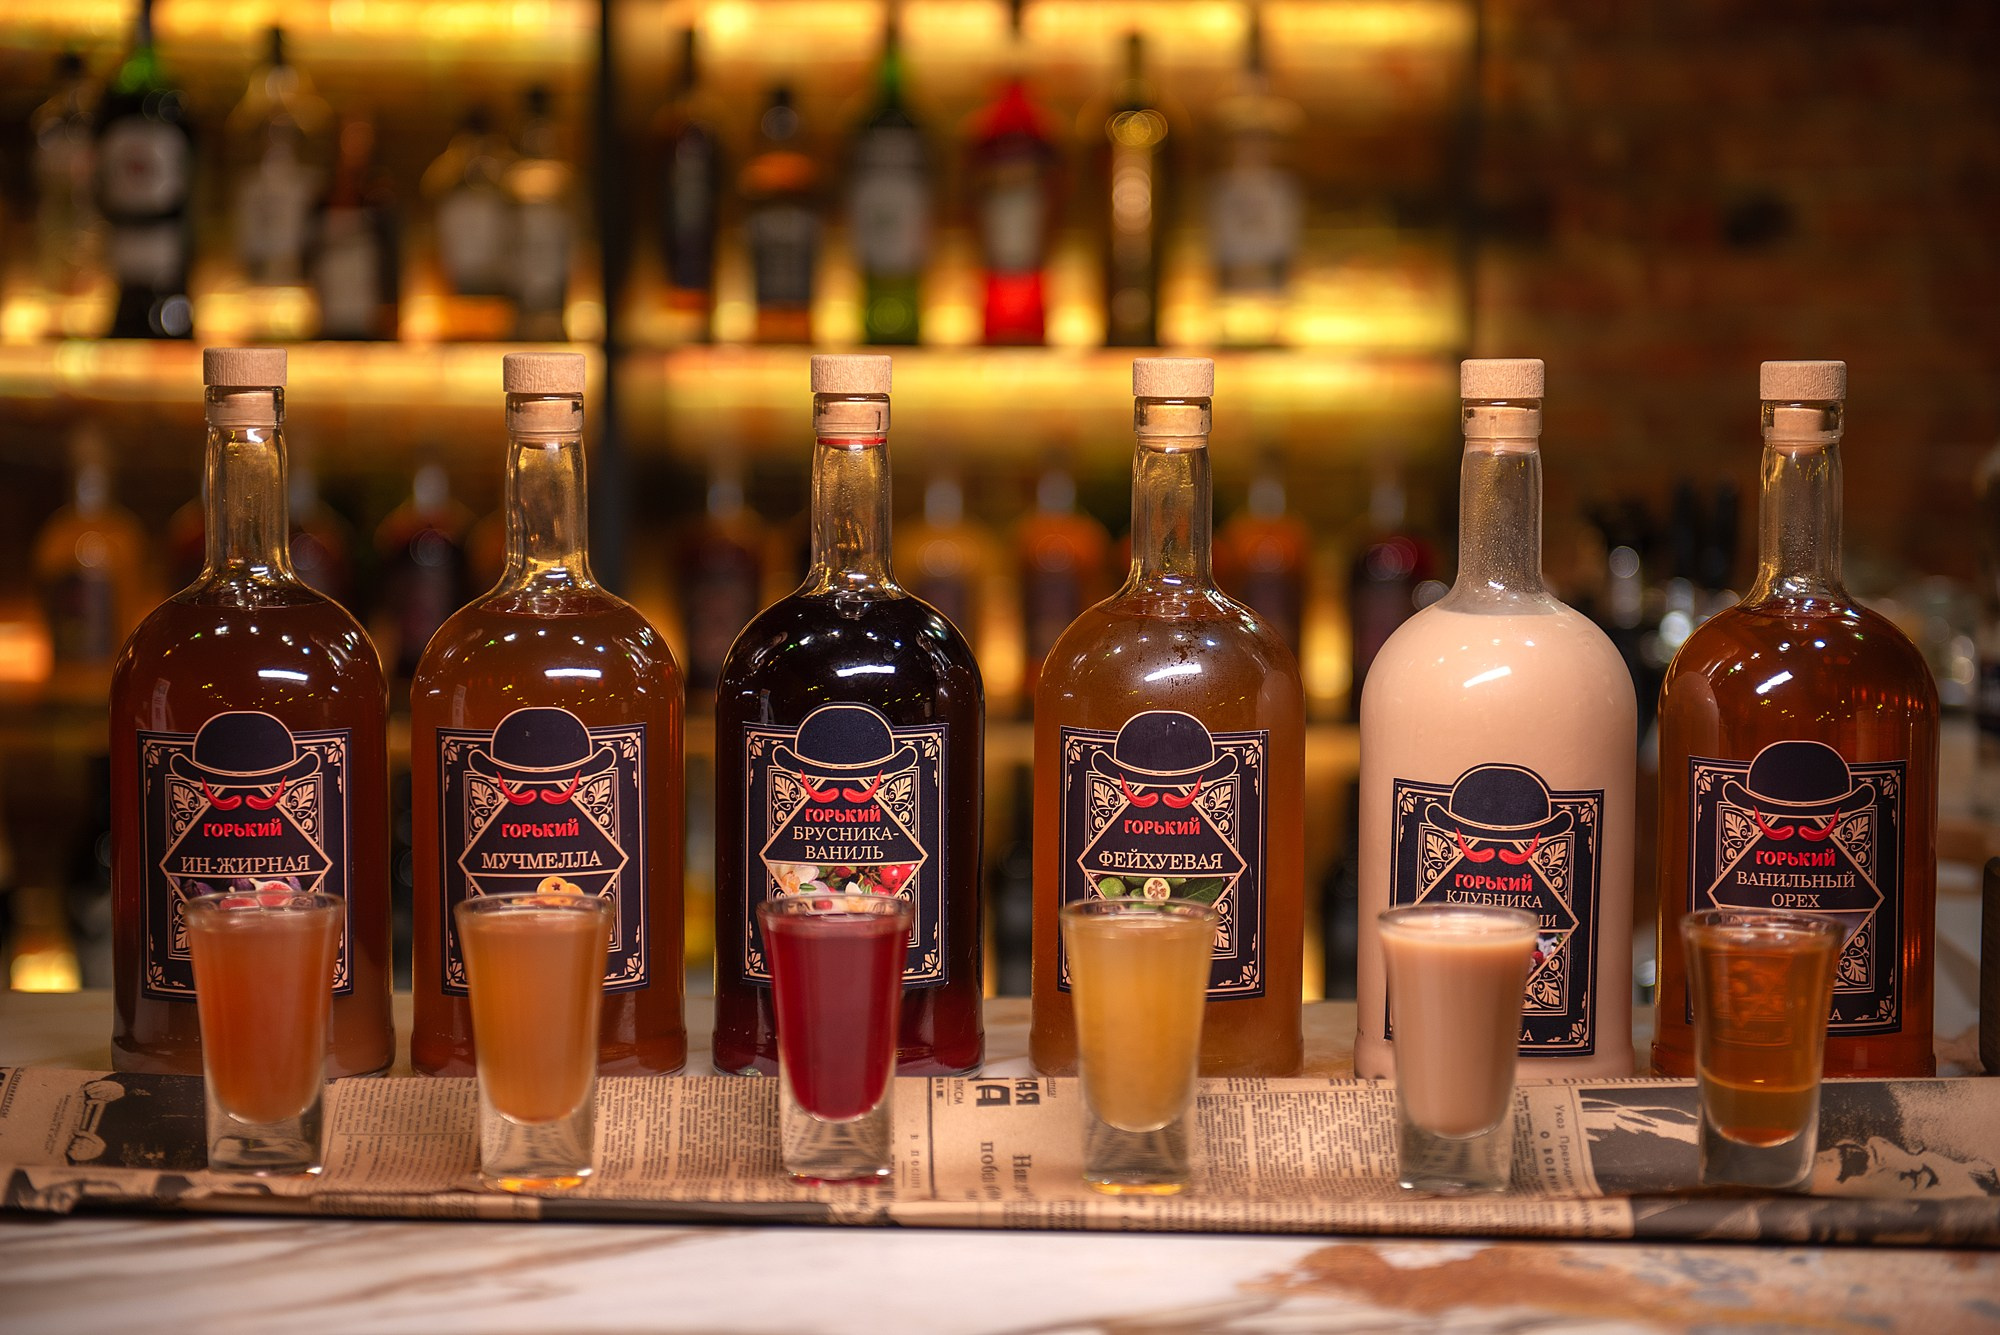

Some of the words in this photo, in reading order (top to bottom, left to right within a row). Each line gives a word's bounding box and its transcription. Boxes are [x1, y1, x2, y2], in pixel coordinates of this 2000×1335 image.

[804, 805, 881, 823] ГОРЬКИЙ
[203, 818, 283, 838] ГОРЬКИЙ
[501, 818, 579, 838] ГОРЬКИЙ
[792, 826, 900, 842] БРУСНИКА-
[1124, 817, 1200, 835] ГОРЬКИЙ
[481, 850, 603, 870] МУЧМЕЛЛА
[804, 845, 884, 860] ВАНИЛЬ
[1098, 848, 1223, 870] ФЕЙХУЕВАЯ
[1756, 848, 1836, 867] ГОРЬКИЙ
[180, 855, 310, 874] ИН-ЖИРНАЯ
[1455, 873, 1533, 892] ГОРЬКИЙ
[1736, 870, 1857, 889] ВАНИЛЬНЫЙ
[1446, 889, 1543, 908] КЛУБНИКА
[1771, 892, 1821, 908] ОРЕХ
